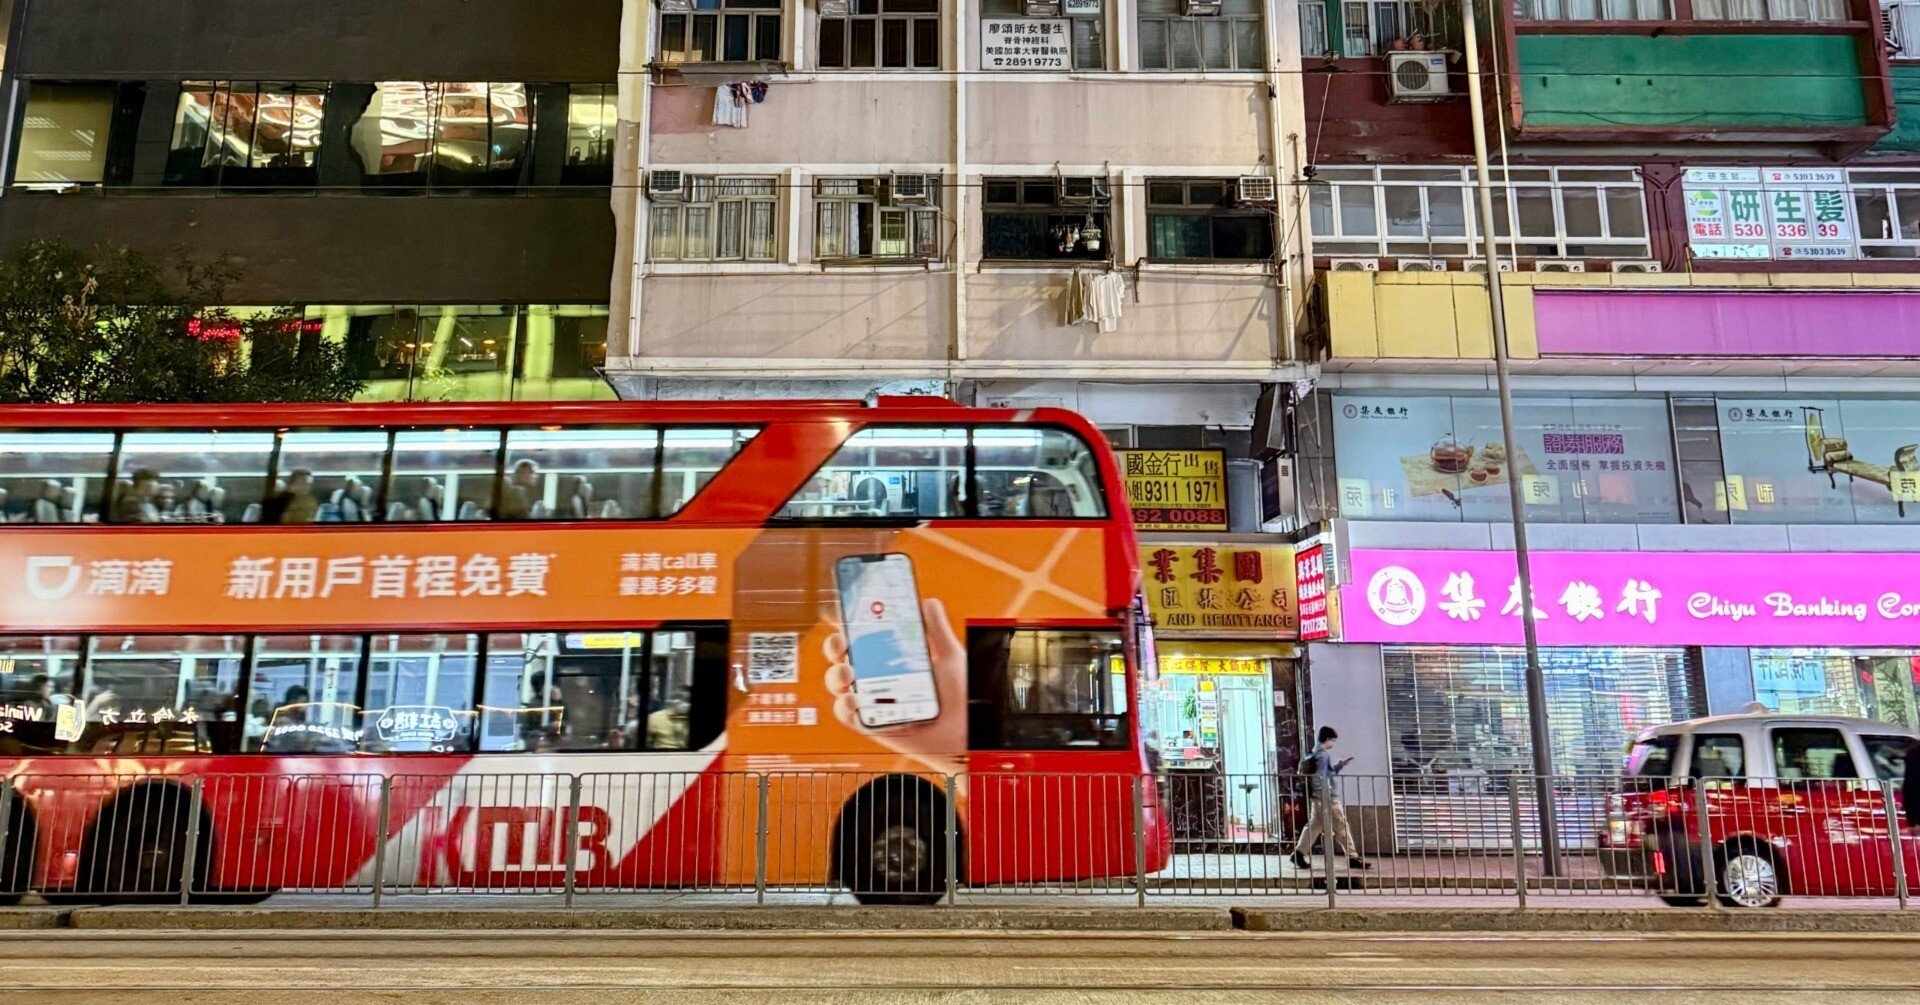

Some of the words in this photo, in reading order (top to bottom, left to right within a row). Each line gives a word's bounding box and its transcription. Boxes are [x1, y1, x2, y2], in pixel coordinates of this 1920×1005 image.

[1005, 57, 1062, 67] 28919773
[1693, 223, 1722, 236] 電話
[1734, 224, 1764, 237] 530
[1777, 224, 1808, 237] 336
[1818, 224, 1838, 237] 39
[1544, 434, 1624, 455] 證券服務
[1546, 459, 1590, 471] 全面服務
[1186, 481, 1219, 502] 1971
[1169, 509, 1222, 523] 0088
[87, 558, 172, 595] 滴滴
[226, 553, 550, 599] 新用戶首程免費
[1687, 592, 1757, 622] Chiyu
[1763, 592, 1867, 622] Banking
[1167, 613, 1196, 626] AND
[1203, 613, 1293, 627] REMITTANCE
[420, 806, 613, 887] KMB
